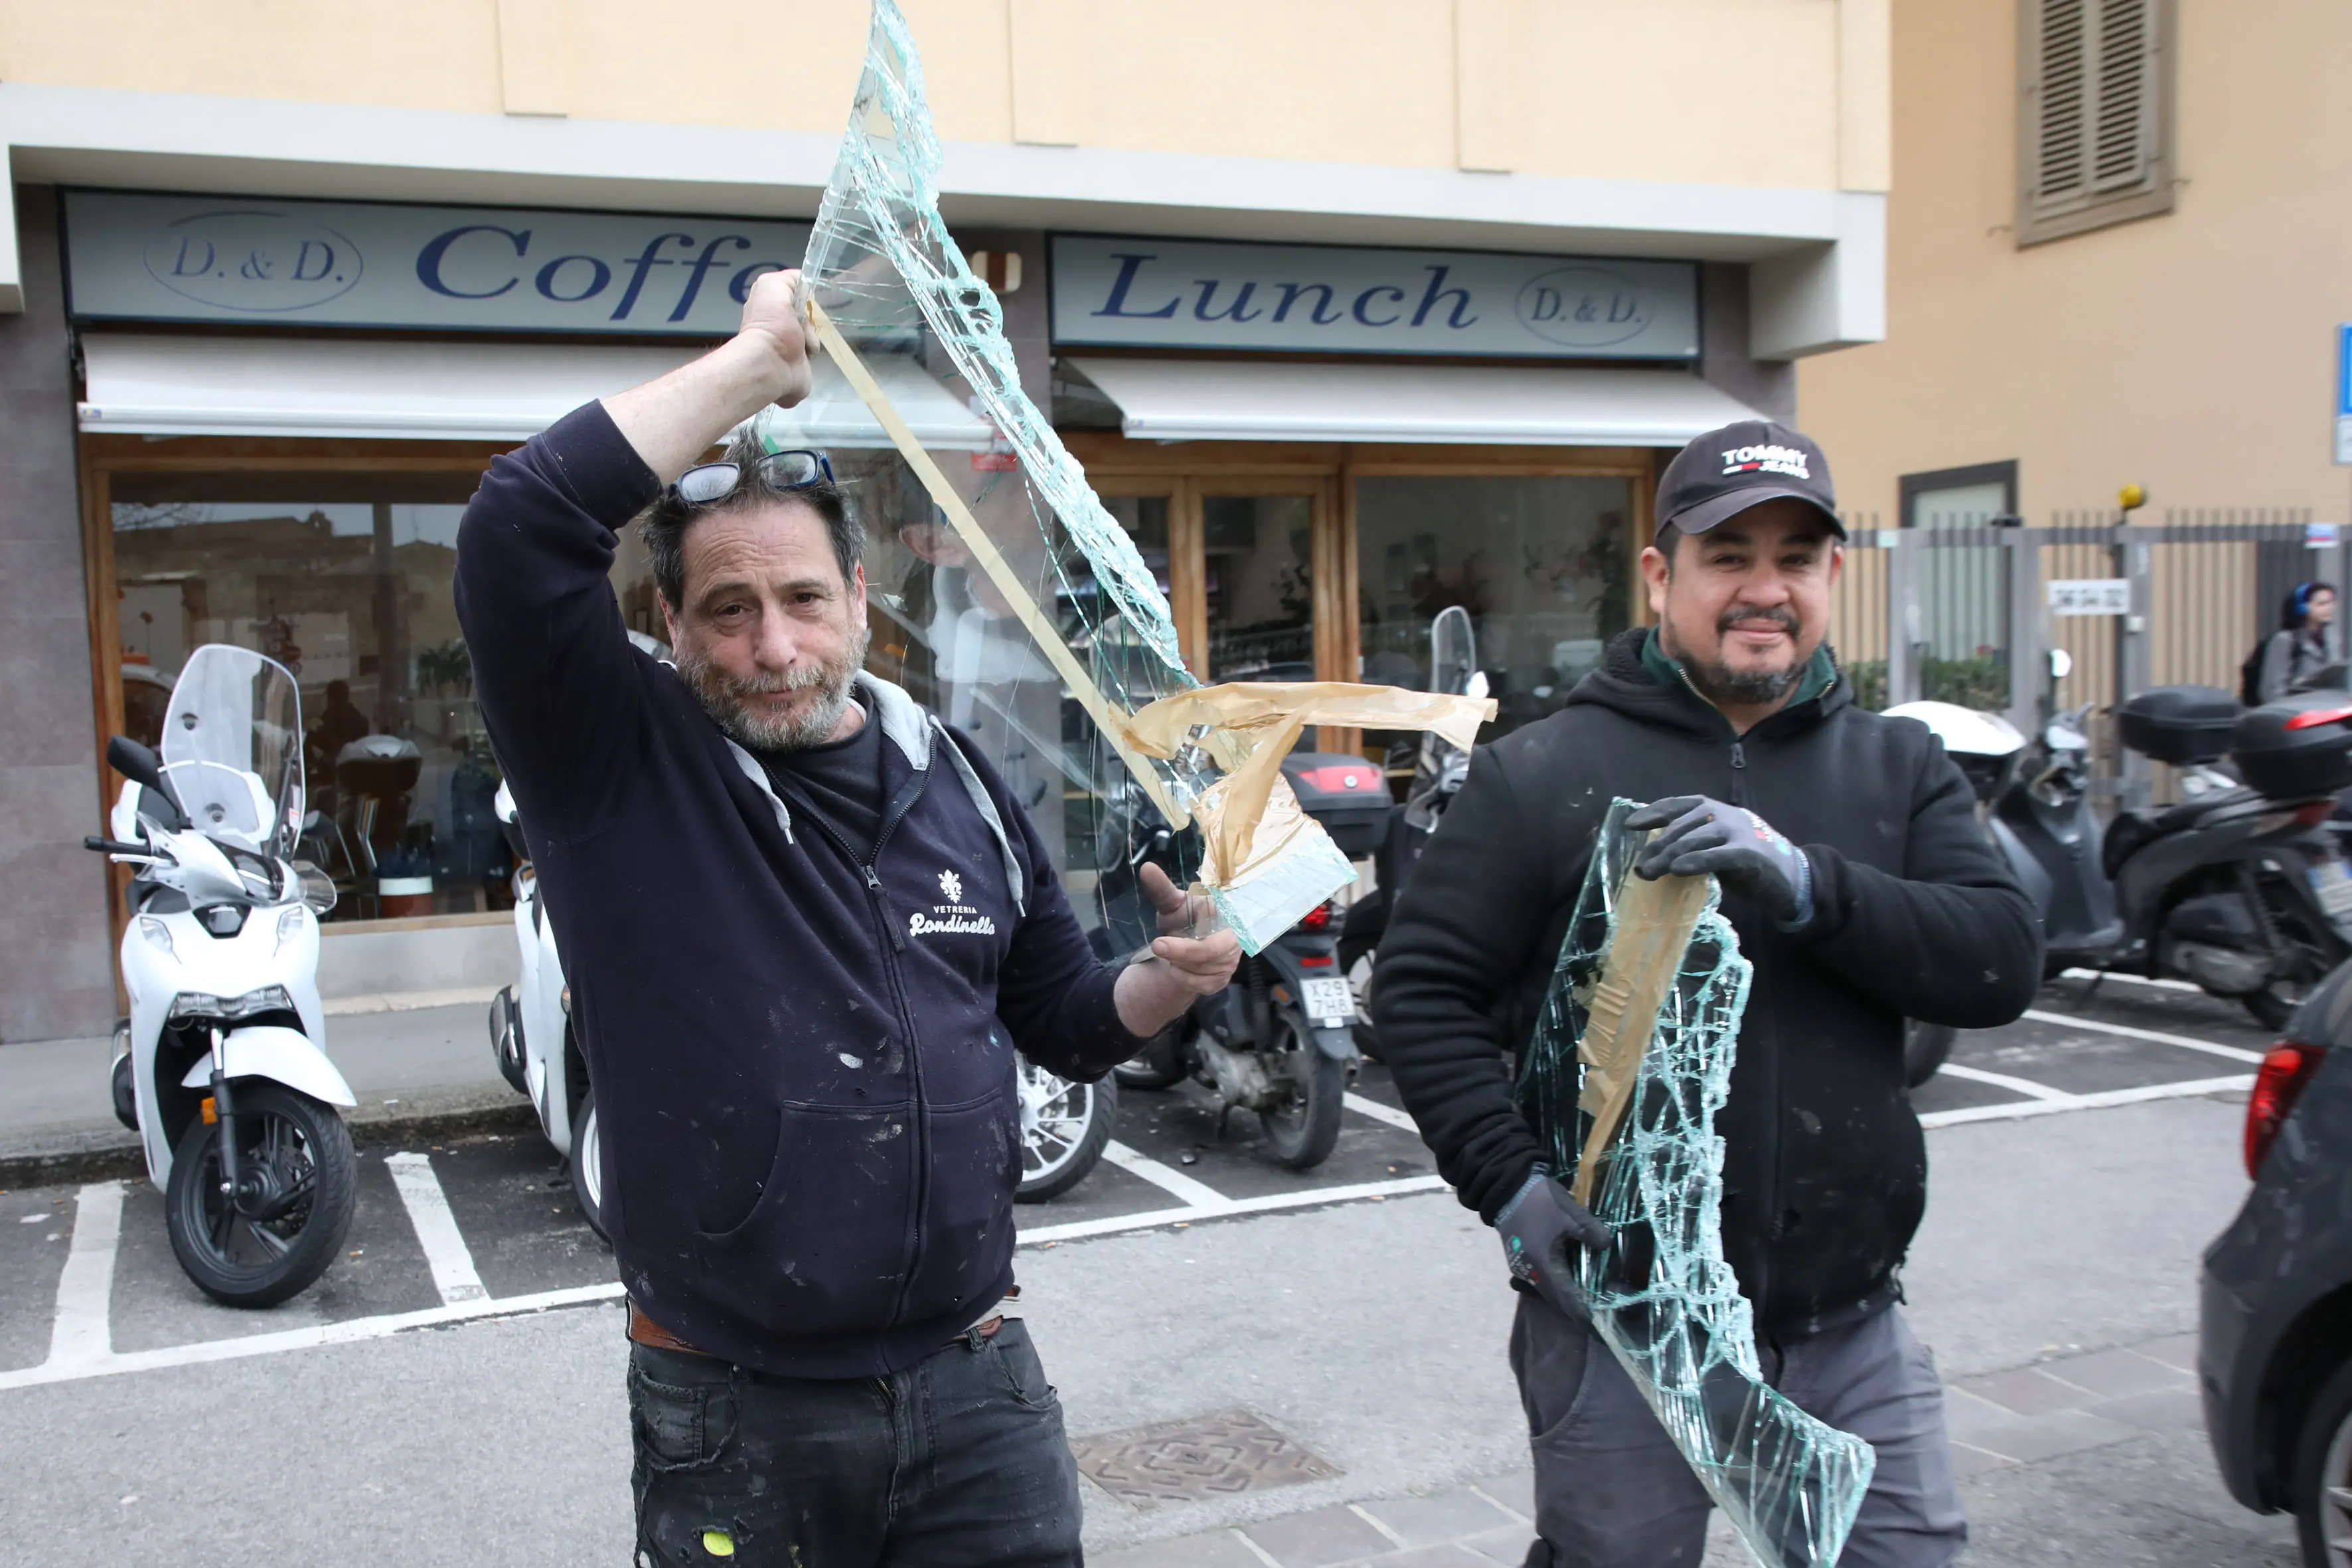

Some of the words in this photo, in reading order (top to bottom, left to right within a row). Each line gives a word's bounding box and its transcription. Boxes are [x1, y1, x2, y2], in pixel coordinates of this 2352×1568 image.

[171, 235, 224, 278] D.
[240, 248, 272, 280] &
[290, 240, 343, 282] D.
[1090, 253, 1478, 330] Lunch
[1531, 287, 1567, 321] D.
[1574, 295, 1597, 323] &
[1607, 292, 1642, 323] D.
[1721, 444, 1808, 468] TOMMY
[933, 905, 977, 914] VETRERIA
[909, 913, 995, 937] Rondinella
